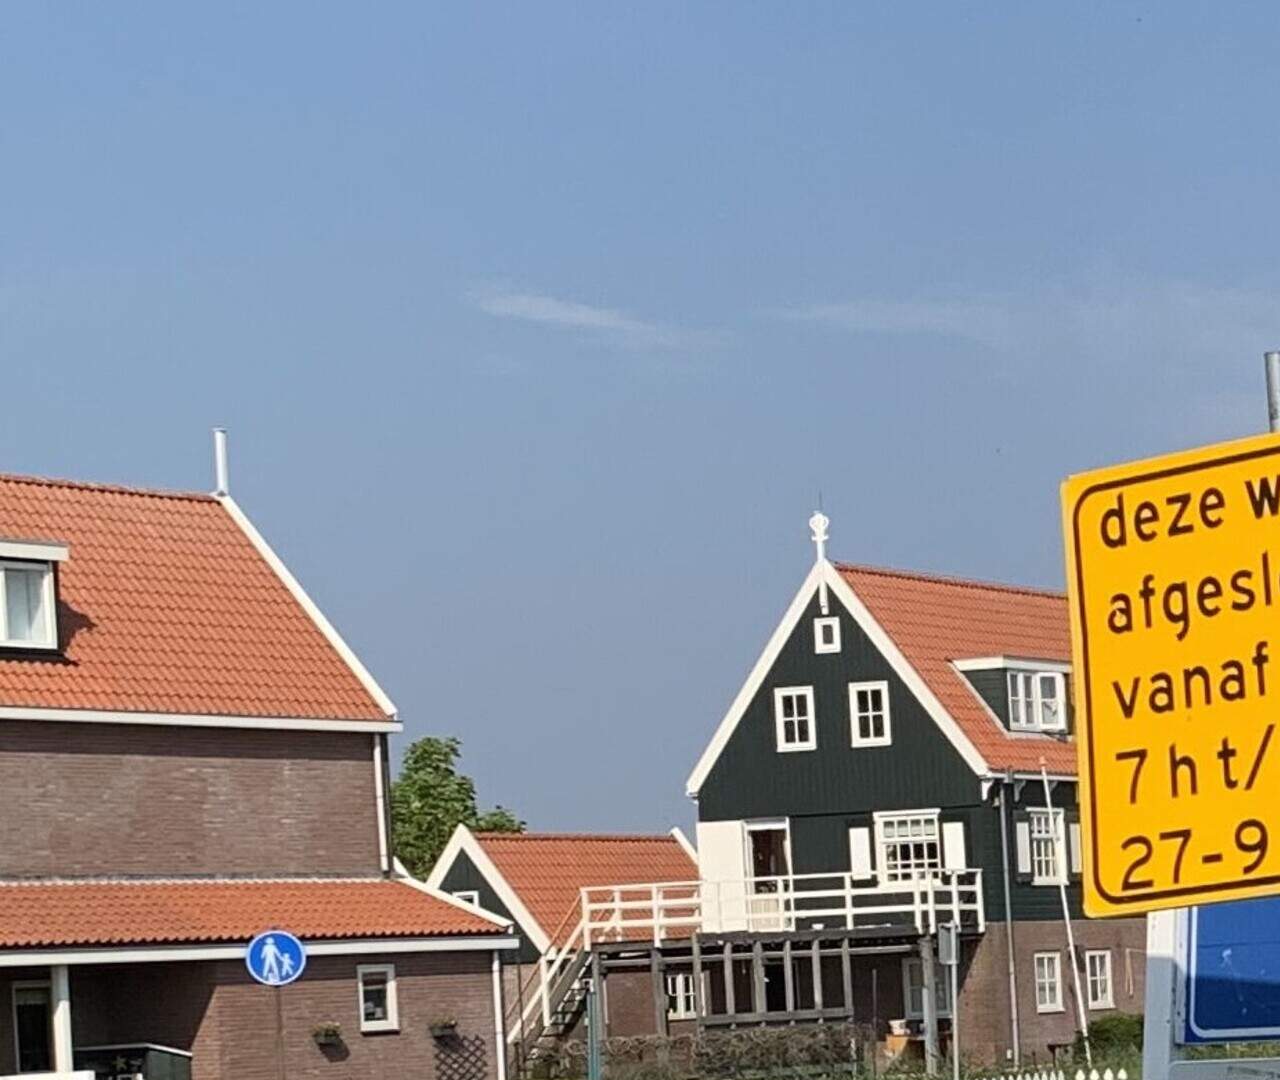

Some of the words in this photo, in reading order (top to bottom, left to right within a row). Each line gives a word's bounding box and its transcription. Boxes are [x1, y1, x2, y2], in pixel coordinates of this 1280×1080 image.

[1100, 487, 1226, 549] deze
[1112, 640, 1269, 719] vanaf
[1121, 818, 1269, 892] 27-9
